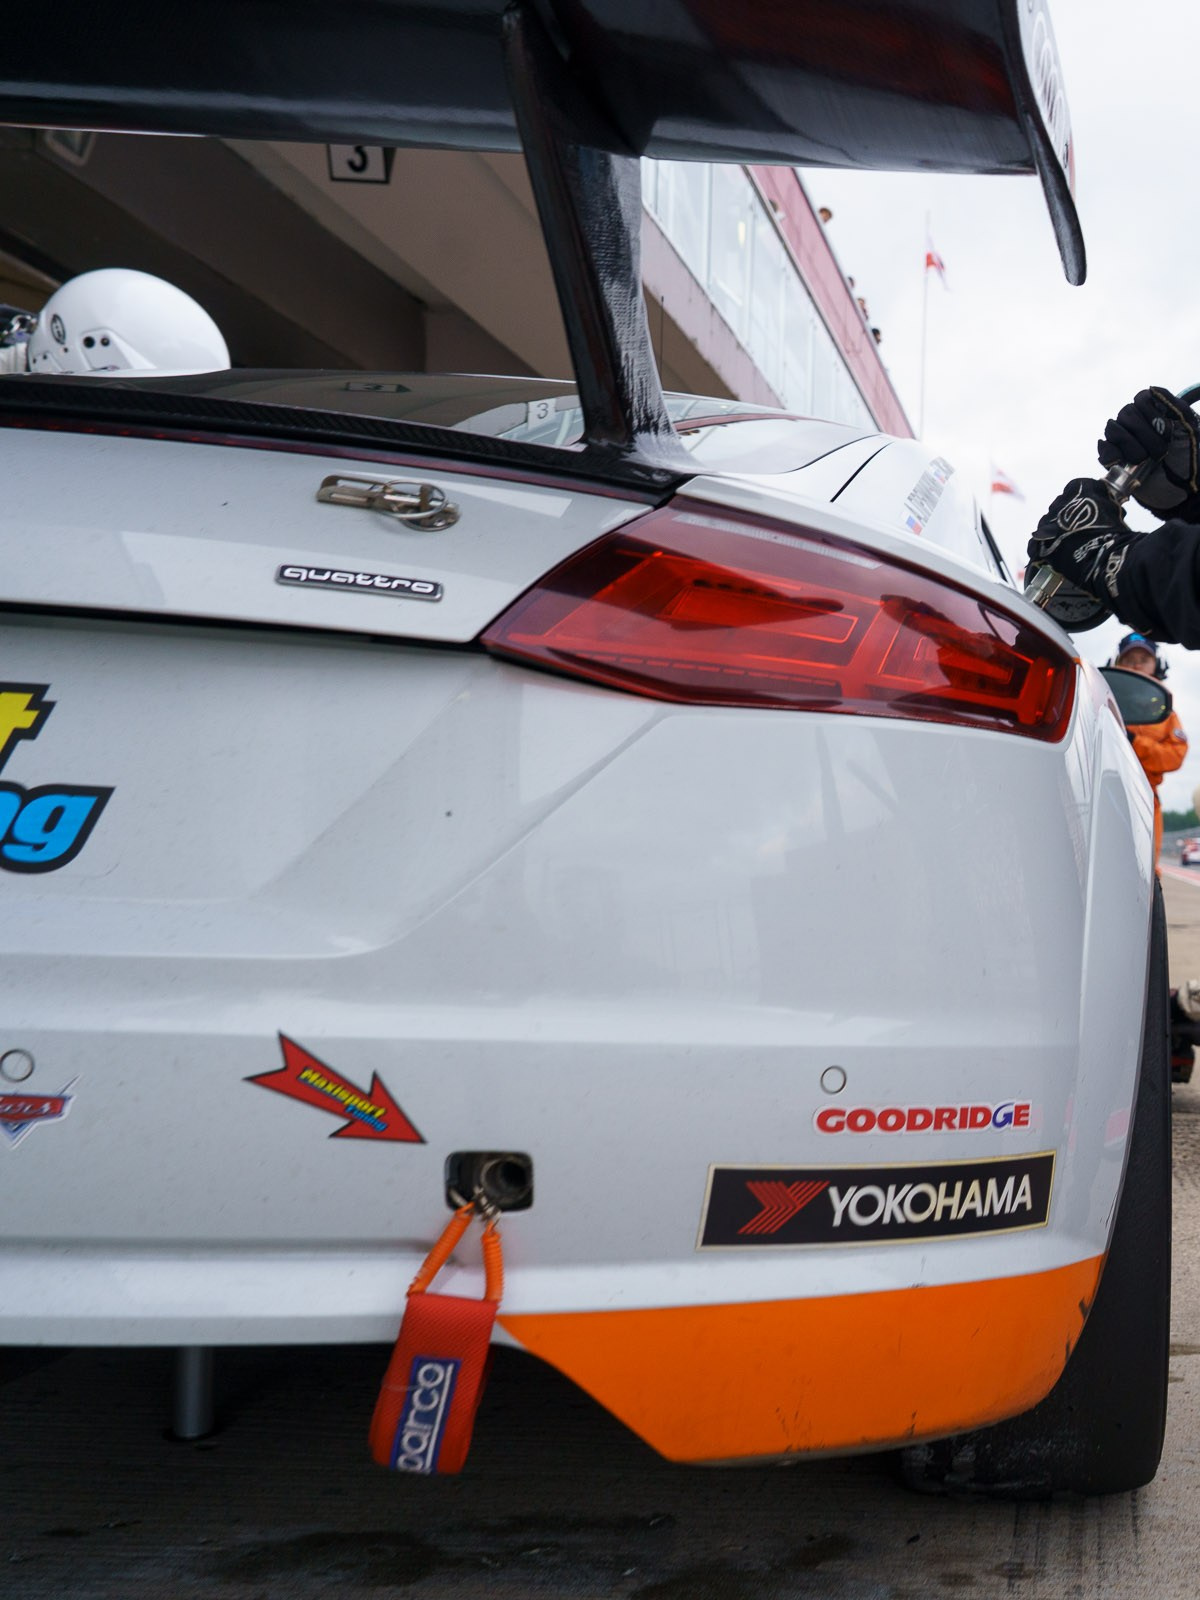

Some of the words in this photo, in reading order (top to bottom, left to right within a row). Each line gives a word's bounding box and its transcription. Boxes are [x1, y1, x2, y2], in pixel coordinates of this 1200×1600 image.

[283, 567, 435, 594] quattro
[816, 1102, 1031, 1134] GOODRIDGE
[827, 1173, 1033, 1228] YOKOHAMA
